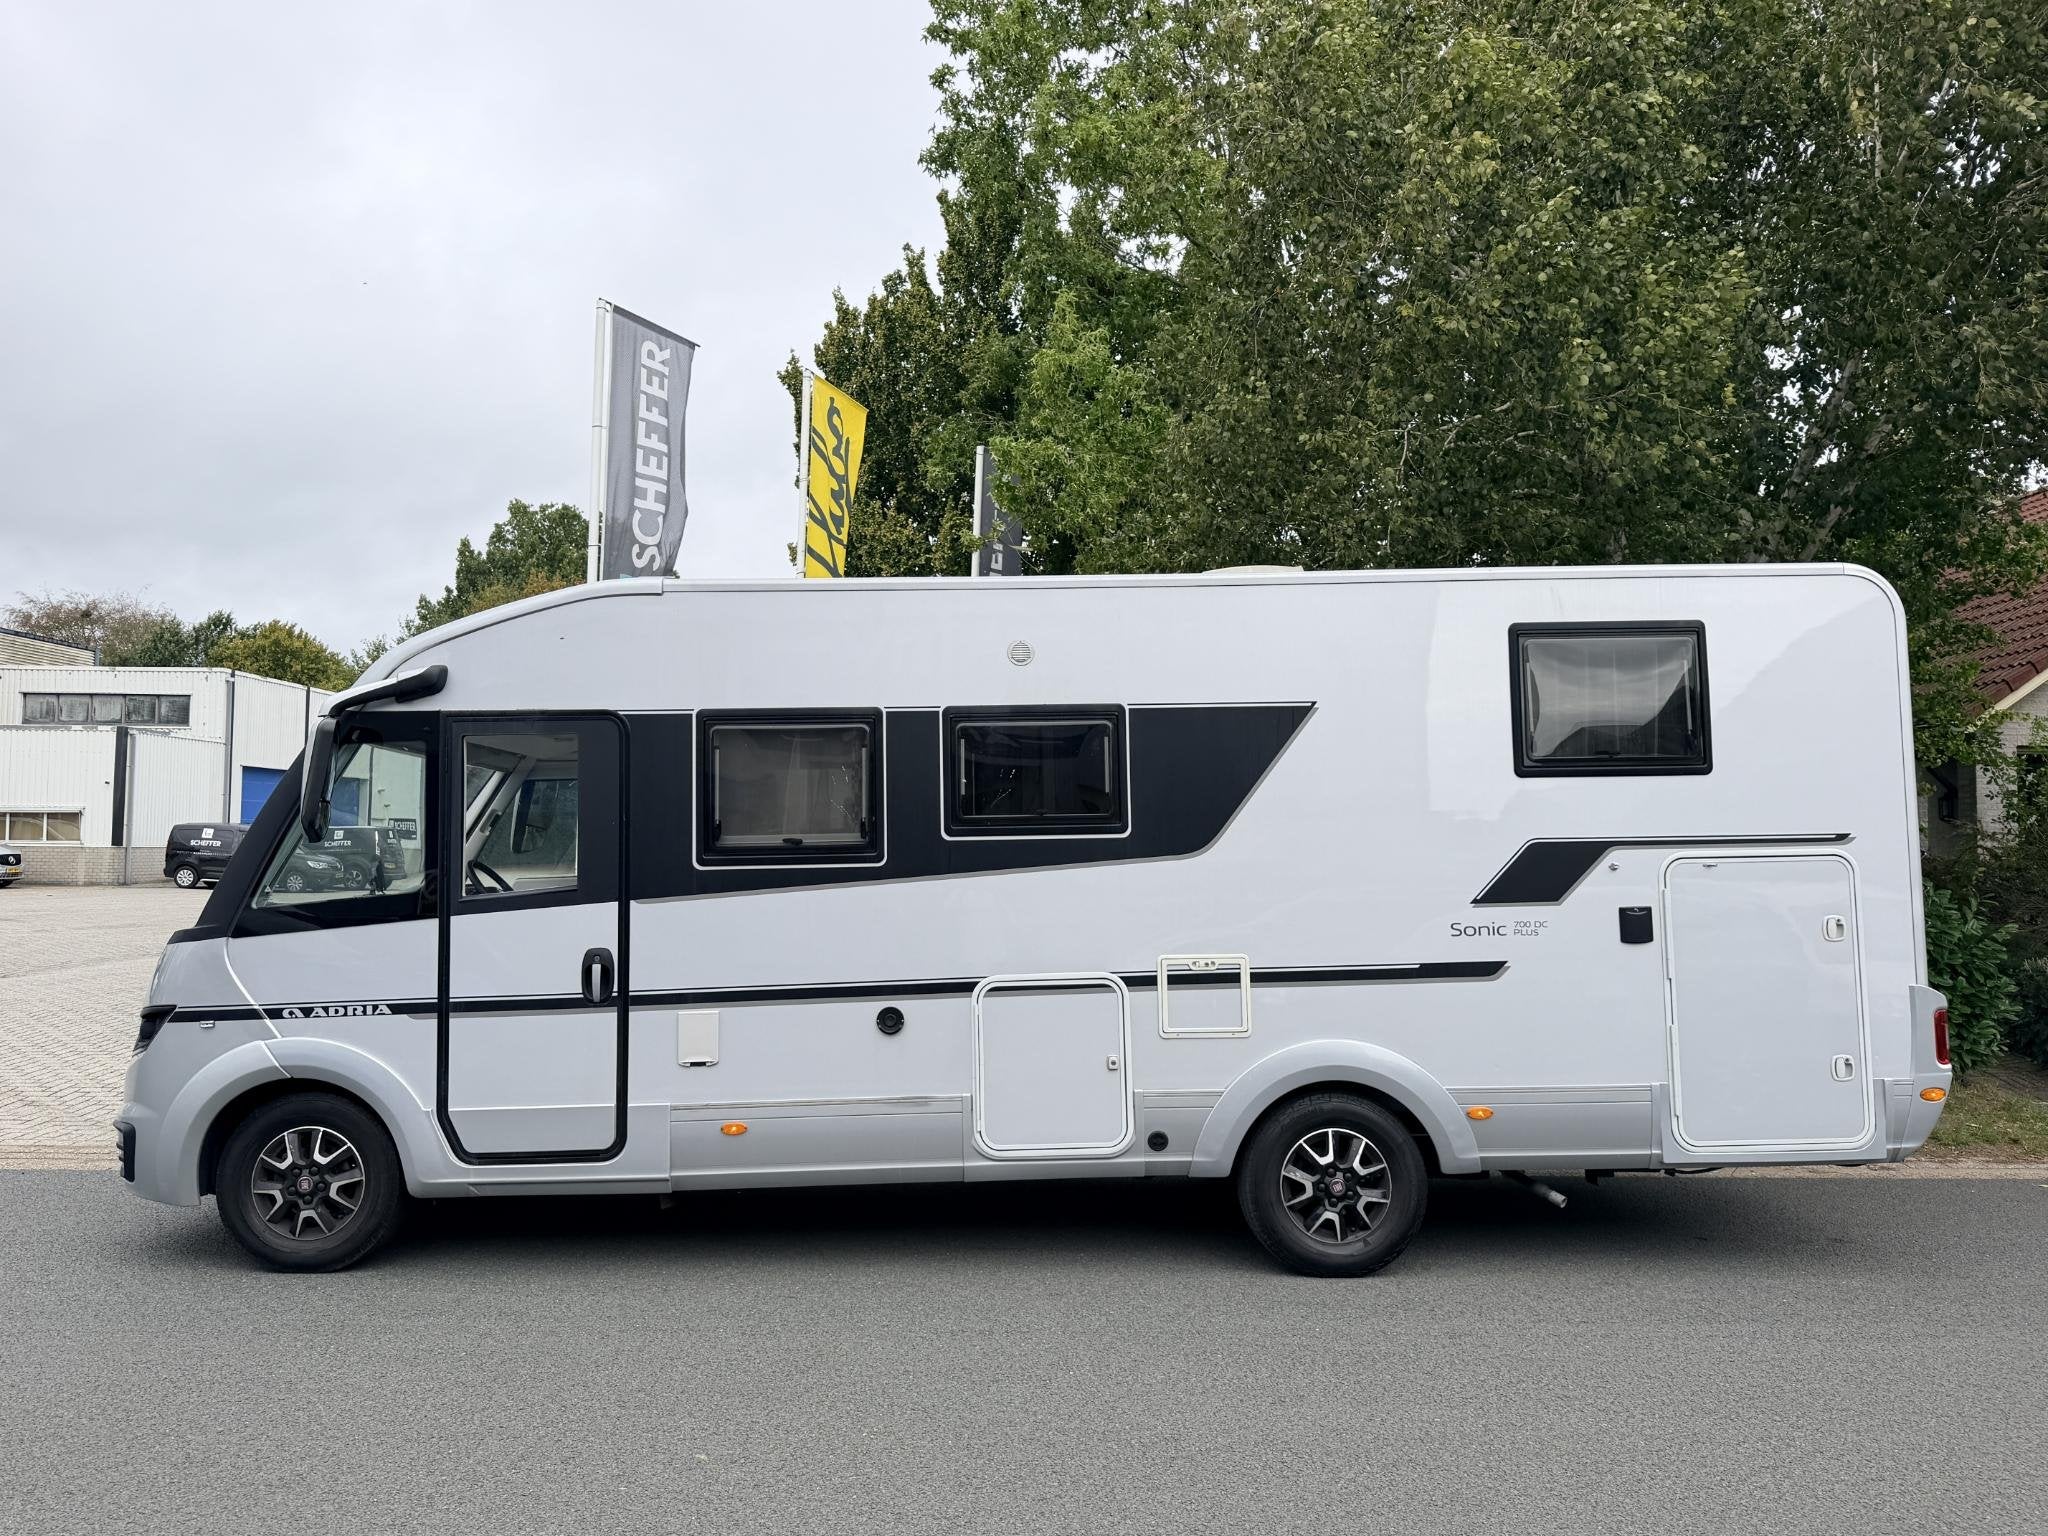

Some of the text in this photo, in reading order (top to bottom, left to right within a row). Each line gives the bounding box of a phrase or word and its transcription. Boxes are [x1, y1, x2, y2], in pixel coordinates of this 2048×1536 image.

[632, 340, 671, 572] SCHEFFER
[190, 839, 221, 847] SCHEFFER
[1450, 921, 1507, 937] Sonic
[1513, 920, 1548, 928] 700 DC
[1513, 928, 1540, 937] PLUS
[309, 1004, 392, 1018] ADRIA
